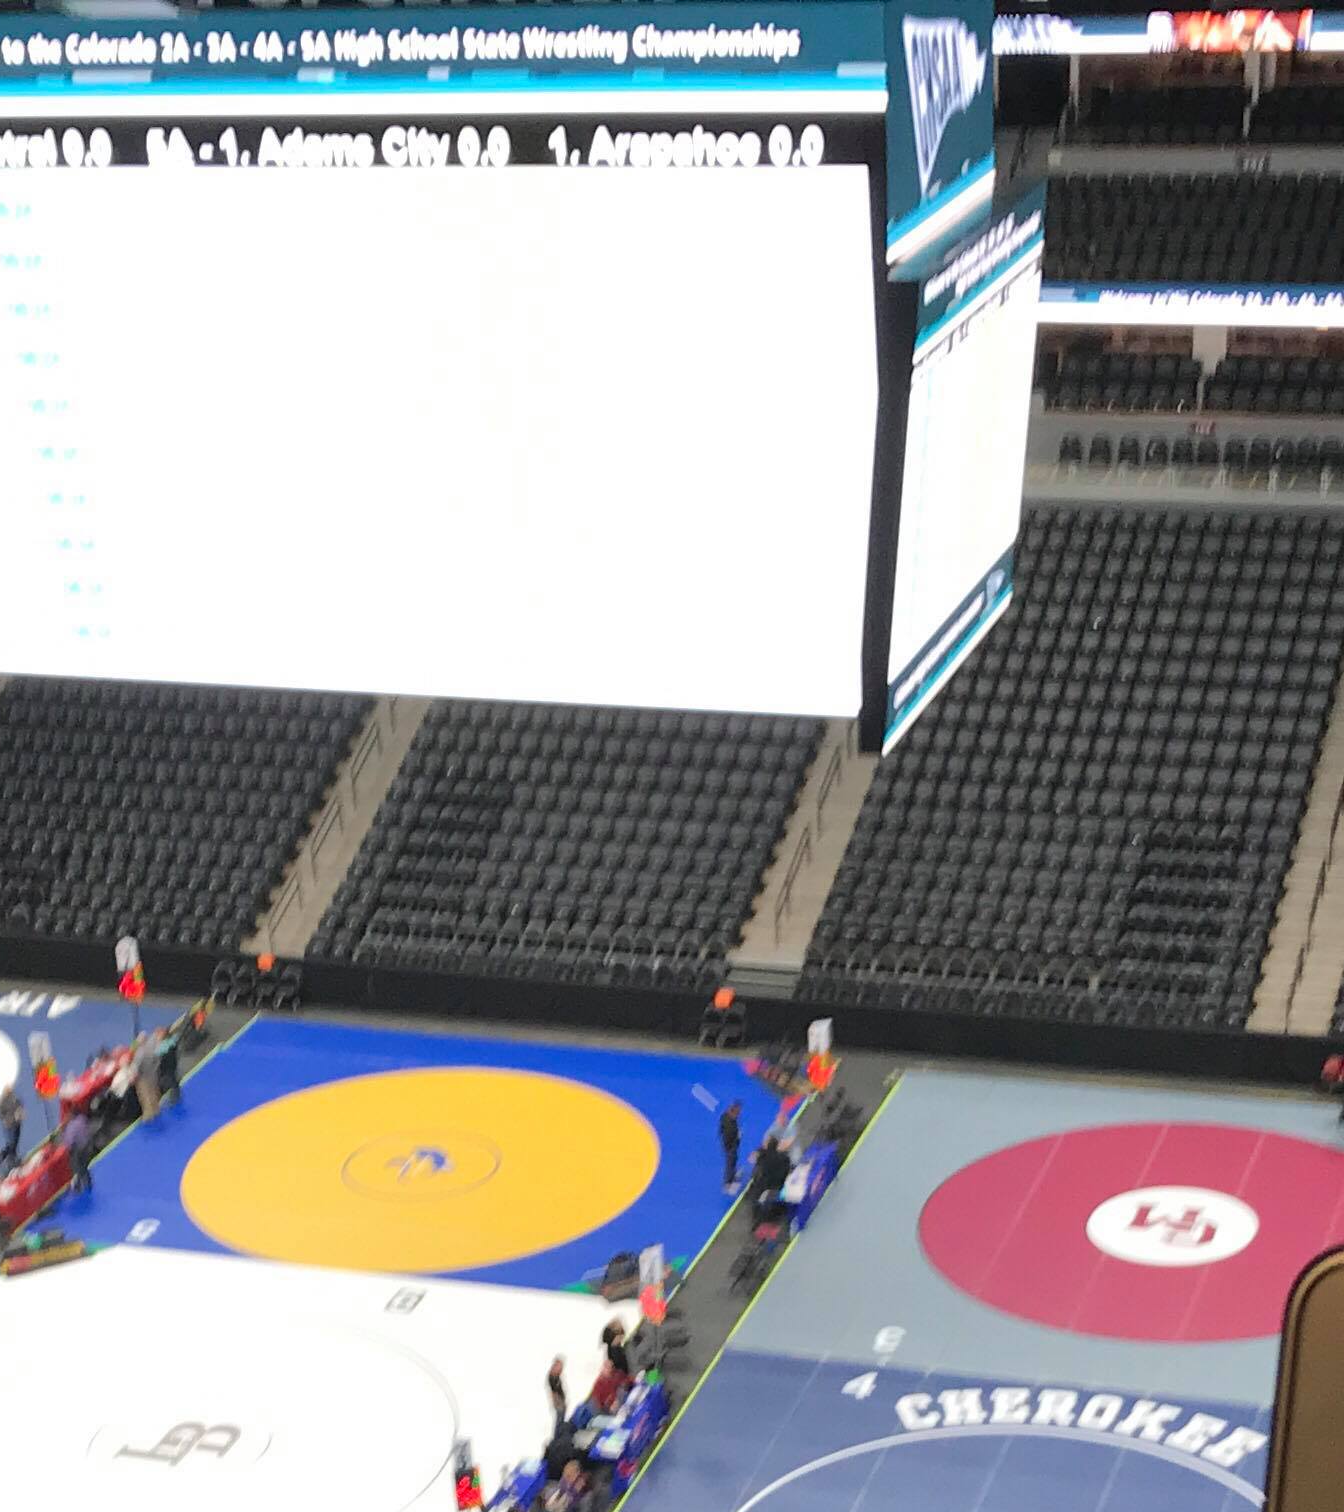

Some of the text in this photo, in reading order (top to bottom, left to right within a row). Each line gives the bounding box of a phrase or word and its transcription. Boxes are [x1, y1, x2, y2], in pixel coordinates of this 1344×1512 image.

[1, 36, 24, 65] to
[27, 33, 62, 65] the
[65, 31, 156, 64] Colorado
[160, 31, 189, 63] 2A
[206, 31, 236, 63] 3A
[253, 31, 282, 62] 4A
[300, 30, 330, 62] 5A
[334, 28, 383, 67] High
[387, 27, 458, 61] School
[462, 28, 519, 60] State
[522, 24, 627, 64] Wrestling
[632, 22, 800, 63] Championships
[62, 127, 112, 167] 0.0
[258, 126, 375, 167] Adams
[381, 125, 450, 168] City
[456, 125, 511, 166] 0.0
[768, 124, 824, 166] 0.0
[895, 1386, 1268, 1468] CHEROKEE
